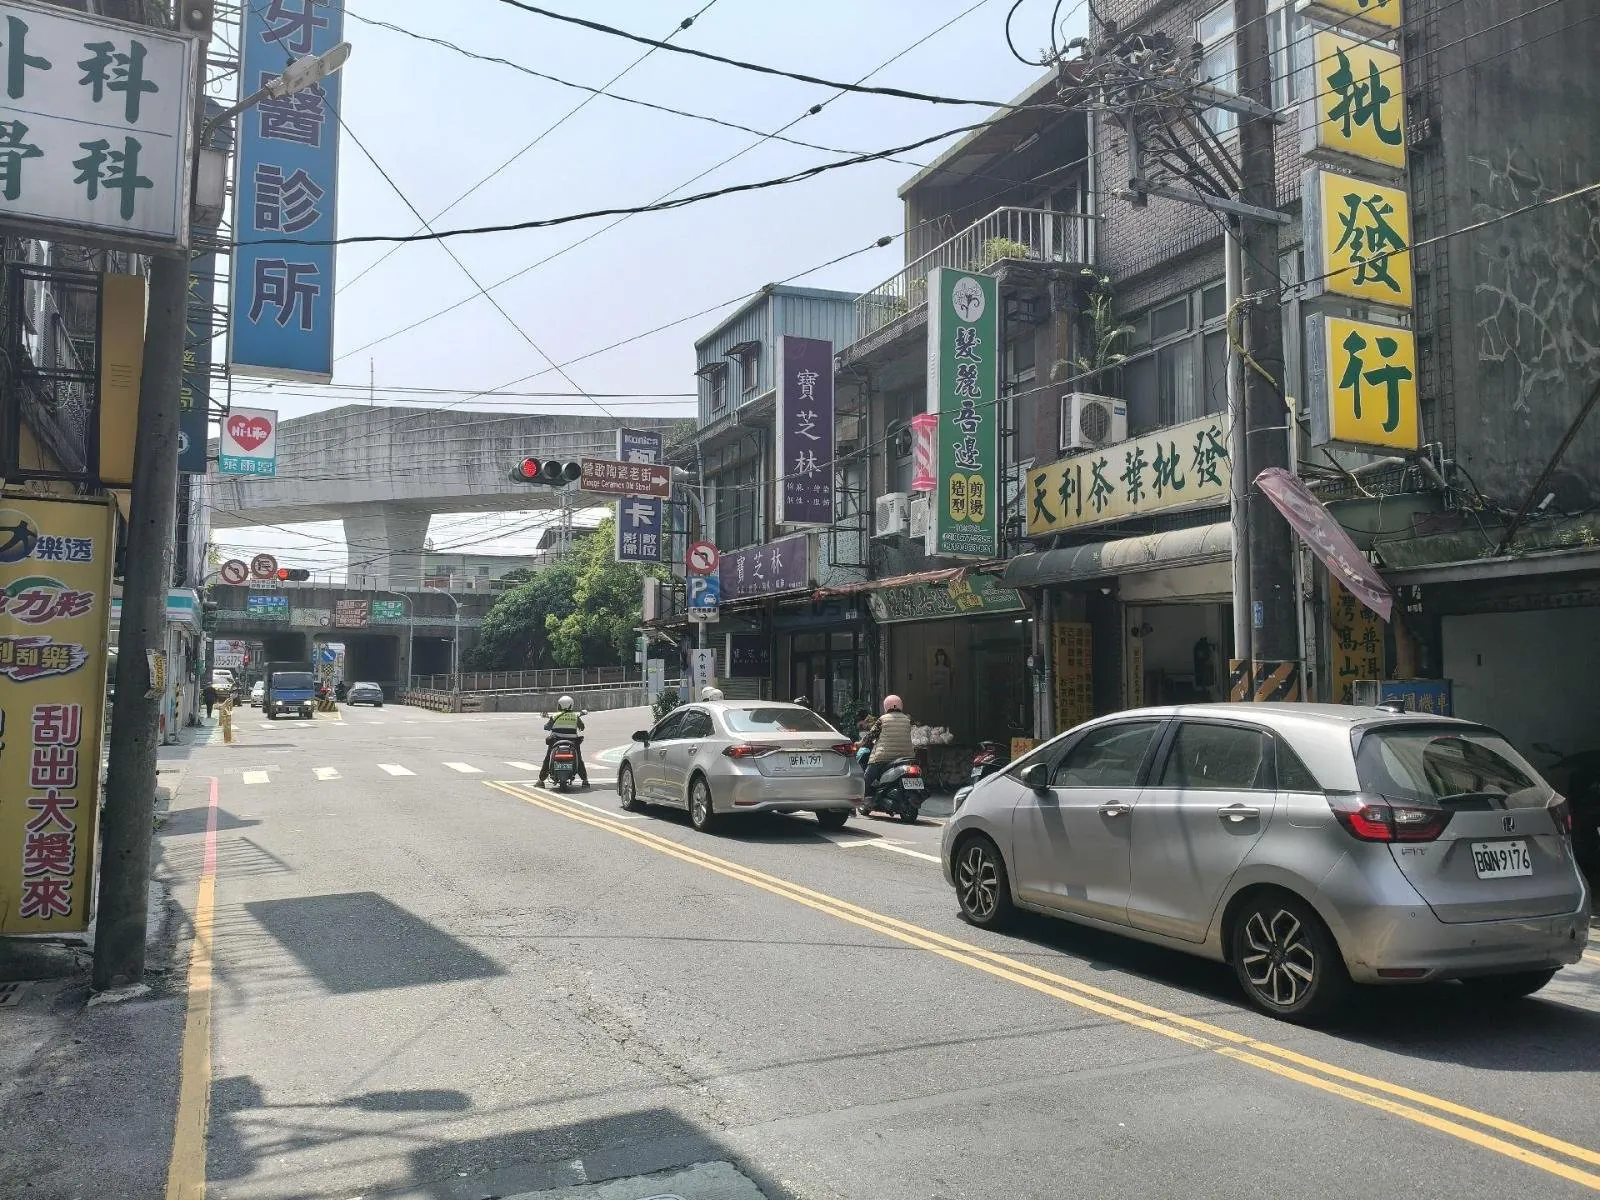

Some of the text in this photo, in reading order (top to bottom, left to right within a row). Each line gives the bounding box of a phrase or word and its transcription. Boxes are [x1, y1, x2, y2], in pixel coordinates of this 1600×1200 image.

[248, 0, 331, 331] 牙醫診所
[795, 368, 821, 479] 寶芝林
[1031, 424, 1229, 527] 天利茶葉批發
[691, 578, 708, 599] P
[20, 704, 79, 917] 刮出大獎來
